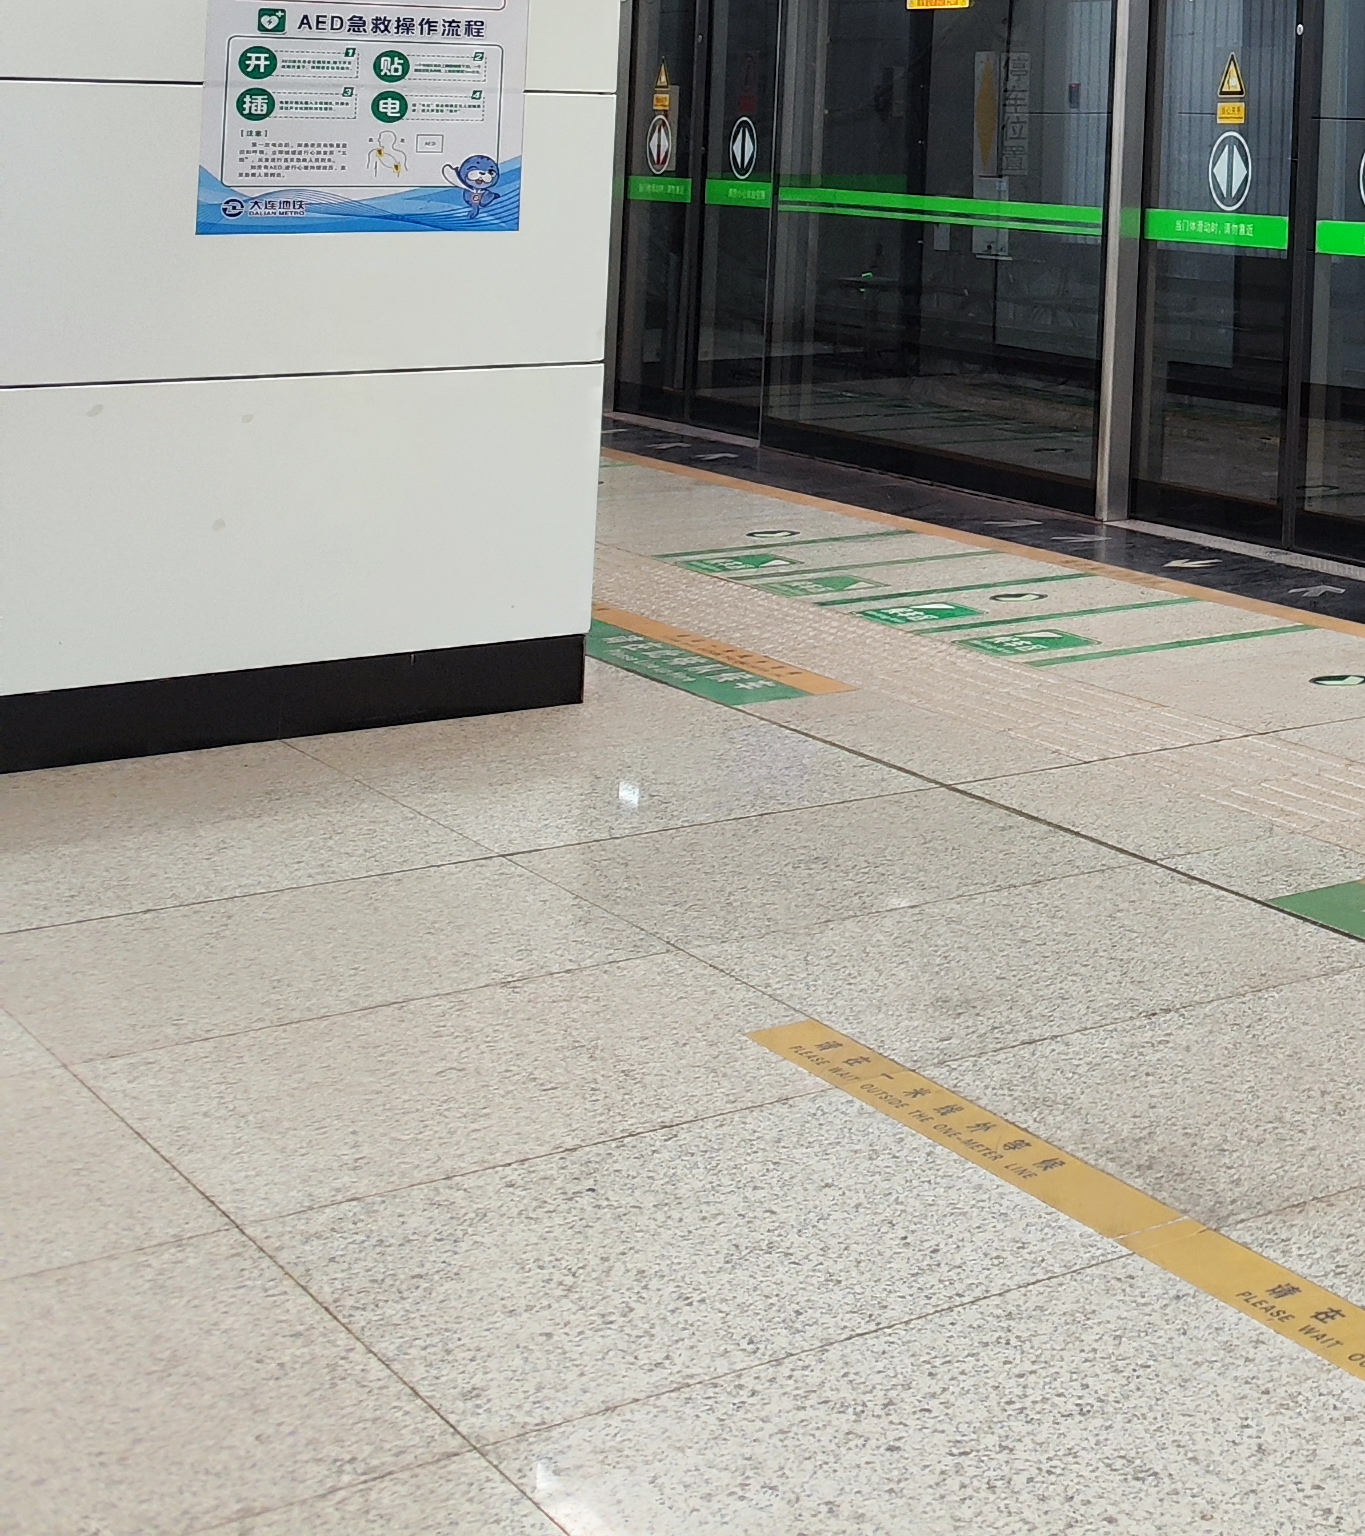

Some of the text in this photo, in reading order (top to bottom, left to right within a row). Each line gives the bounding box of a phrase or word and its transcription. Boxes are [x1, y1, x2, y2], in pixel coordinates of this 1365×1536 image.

[297, 14, 485, 38] AED急救操作流程
[245, 52, 270, 73] 开
[380, 56, 404, 76] 贴
[242, 94, 268, 115] 插
[379, 98, 400, 117] 电
[249, 200, 305, 210] 大连地铁
[788, 1044, 1039, 1181] PLEASE WAIT OUTSIDE THE ONE-METER LINE
[814, 1040, 1066, 1173] 请在一米线外等候
[1235, 1289, 1295, 1325] PLEASE
[1298, 1324, 1345, 1351] WAIT
